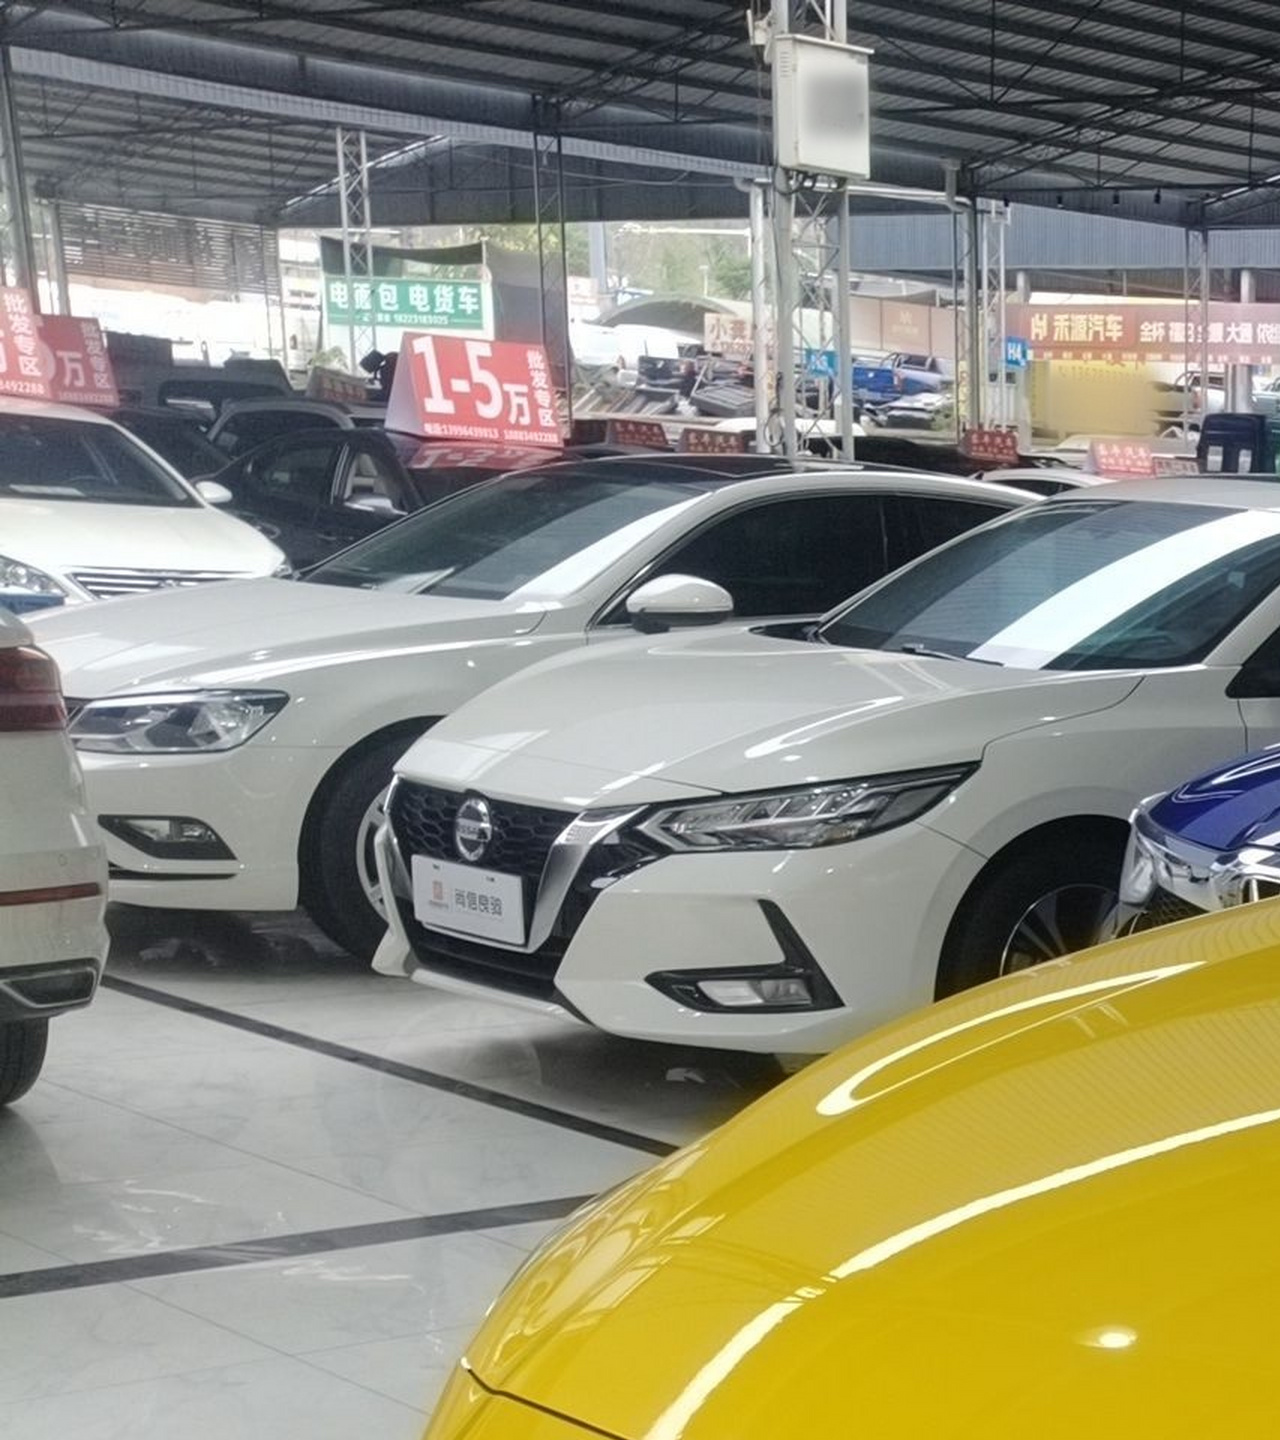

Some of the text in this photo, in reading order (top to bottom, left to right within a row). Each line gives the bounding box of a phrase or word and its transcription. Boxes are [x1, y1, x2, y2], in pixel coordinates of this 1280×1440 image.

[409, 284, 480, 314] 电货车
[4, 293, 42, 377] 批发专区
[1053, 313, 1123, 341] 禾源汽车
[526, 349, 557, 427] 批发专区
